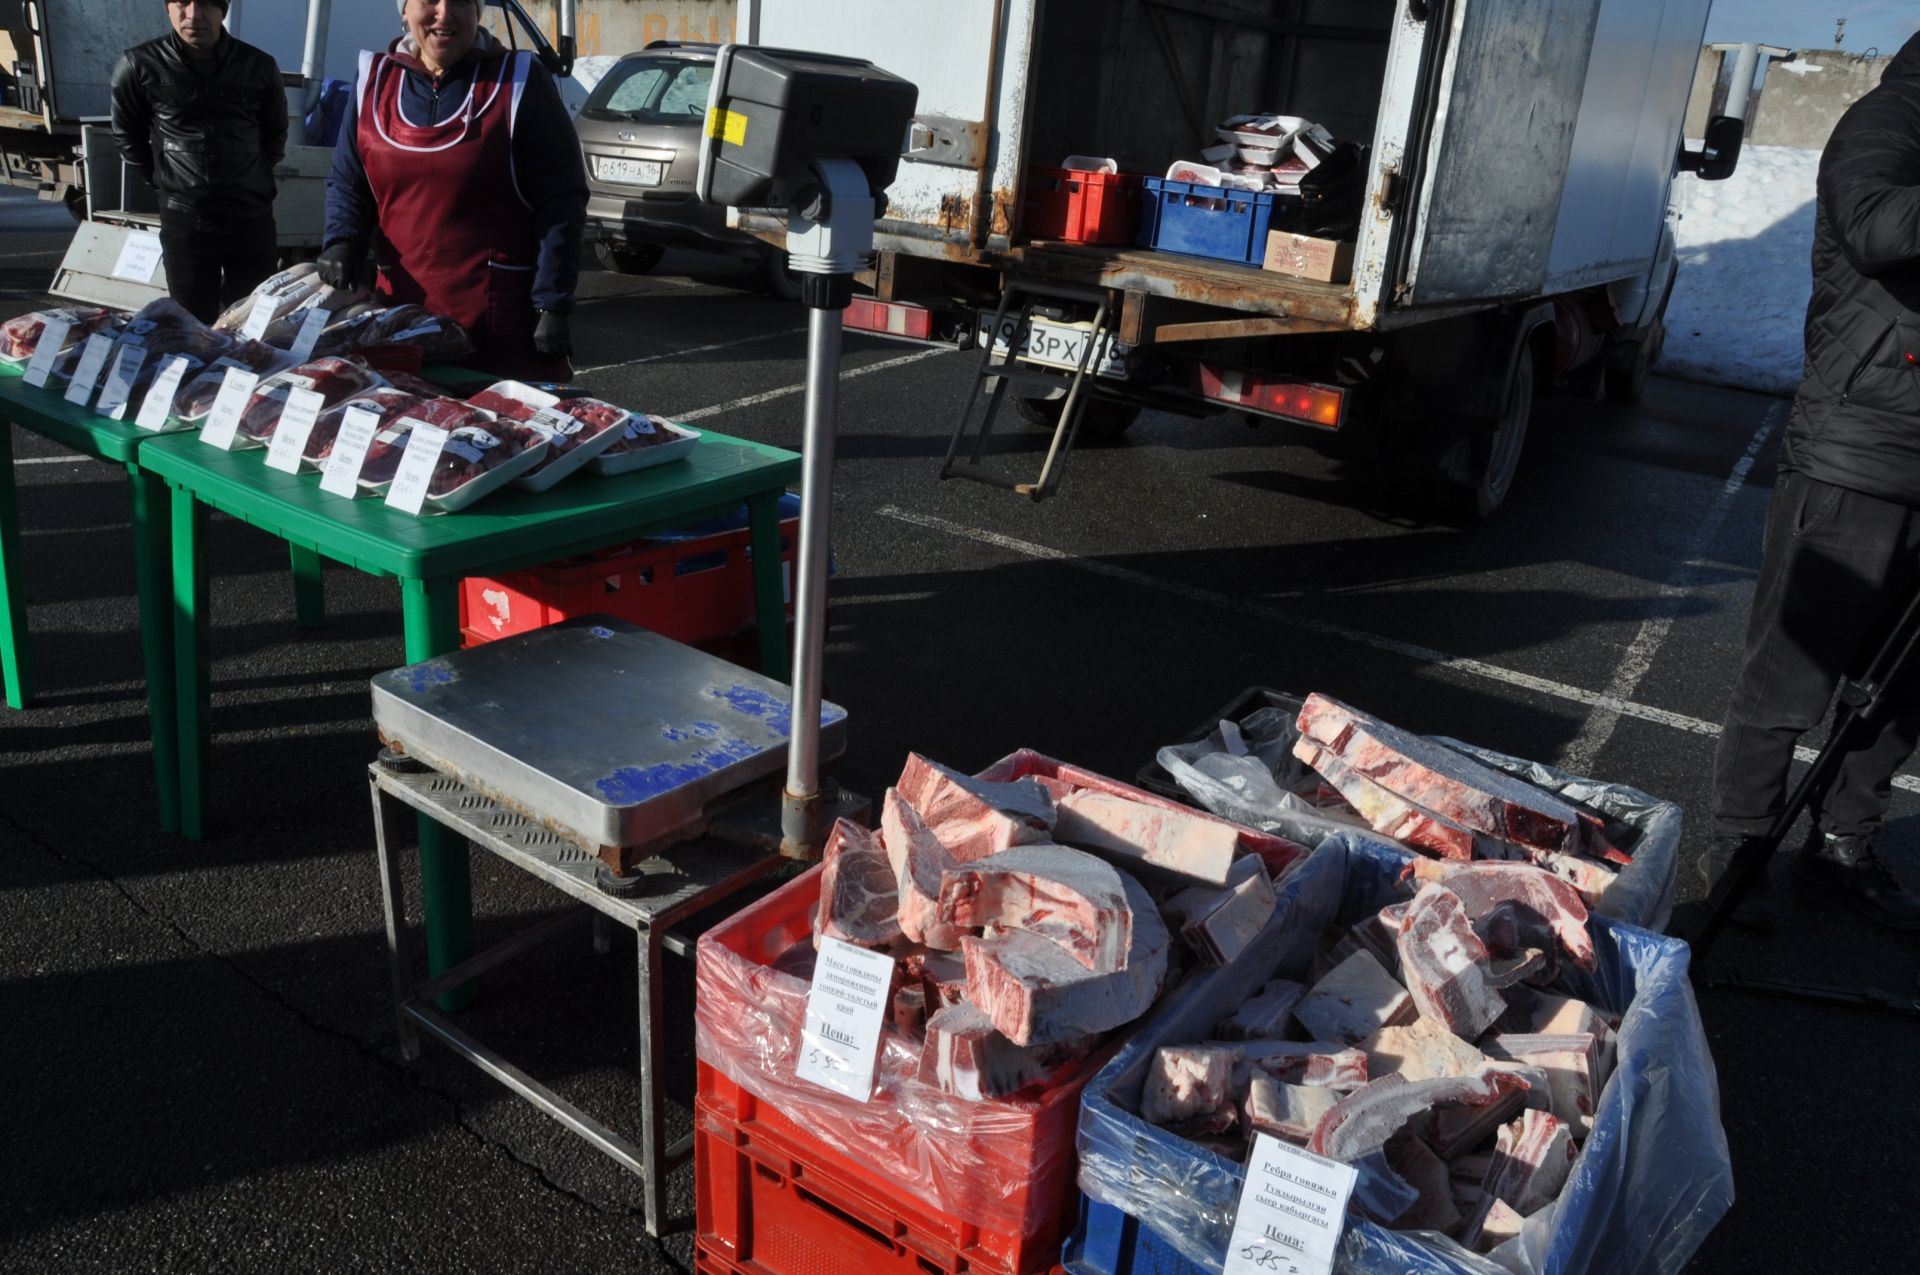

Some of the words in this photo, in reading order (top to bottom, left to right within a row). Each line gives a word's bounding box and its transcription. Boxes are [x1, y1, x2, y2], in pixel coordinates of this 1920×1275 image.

[987, 322, 1077, 362] 923РХ
[825, 971, 877, 996] замороженное
[826, 955, 845, 970] Мясо
[846, 963, 882, 984] говядины
[836, 1002, 854, 1015] край
[820, 1021, 856, 1047] Цена:
[1263, 1161, 1292, 1180] Ребра
[1294, 1174, 1337, 1198] говяжьи
[1255, 1193, 1278, 1208] сыер
[1279, 1202, 1329, 1229] кабыргасы
[1264, 1223, 1305, 1251] Цена:
